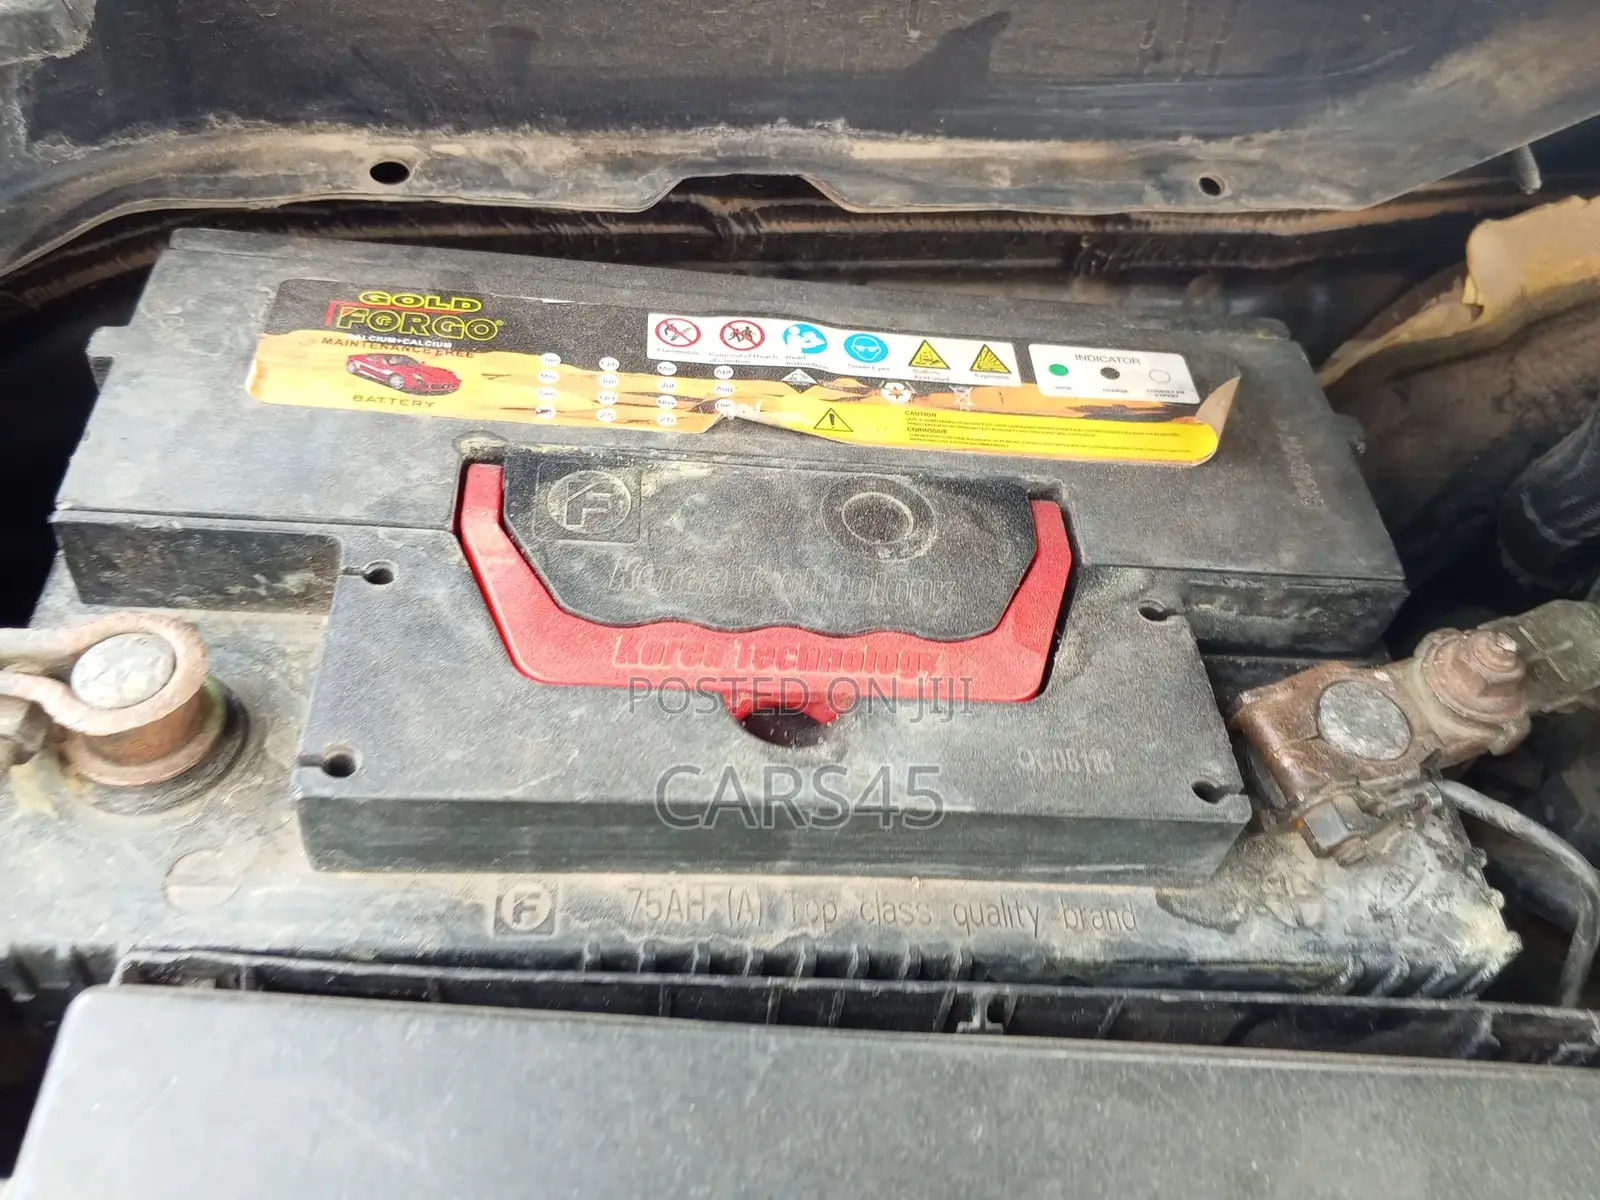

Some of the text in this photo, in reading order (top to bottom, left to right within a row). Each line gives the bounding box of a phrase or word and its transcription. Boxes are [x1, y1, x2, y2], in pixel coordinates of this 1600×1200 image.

[358, 290, 483, 313] GOLD
[337, 305, 500, 341] FORGO
[321, 337, 431, 355] MAINTENANCE
[1075, 353, 1142, 365] INDICATOR
[352, 394, 436, 408] BATTERY
[904, 410, 937, 418] CAUTION
[906, 426, 948, 435] CORROSIVE
[626, 886, 706, 924] 75AH
[859, 891, 933, 927] class
[952, 894, 1041, 938] quality
[1058, 896, 1139, 932] brand
